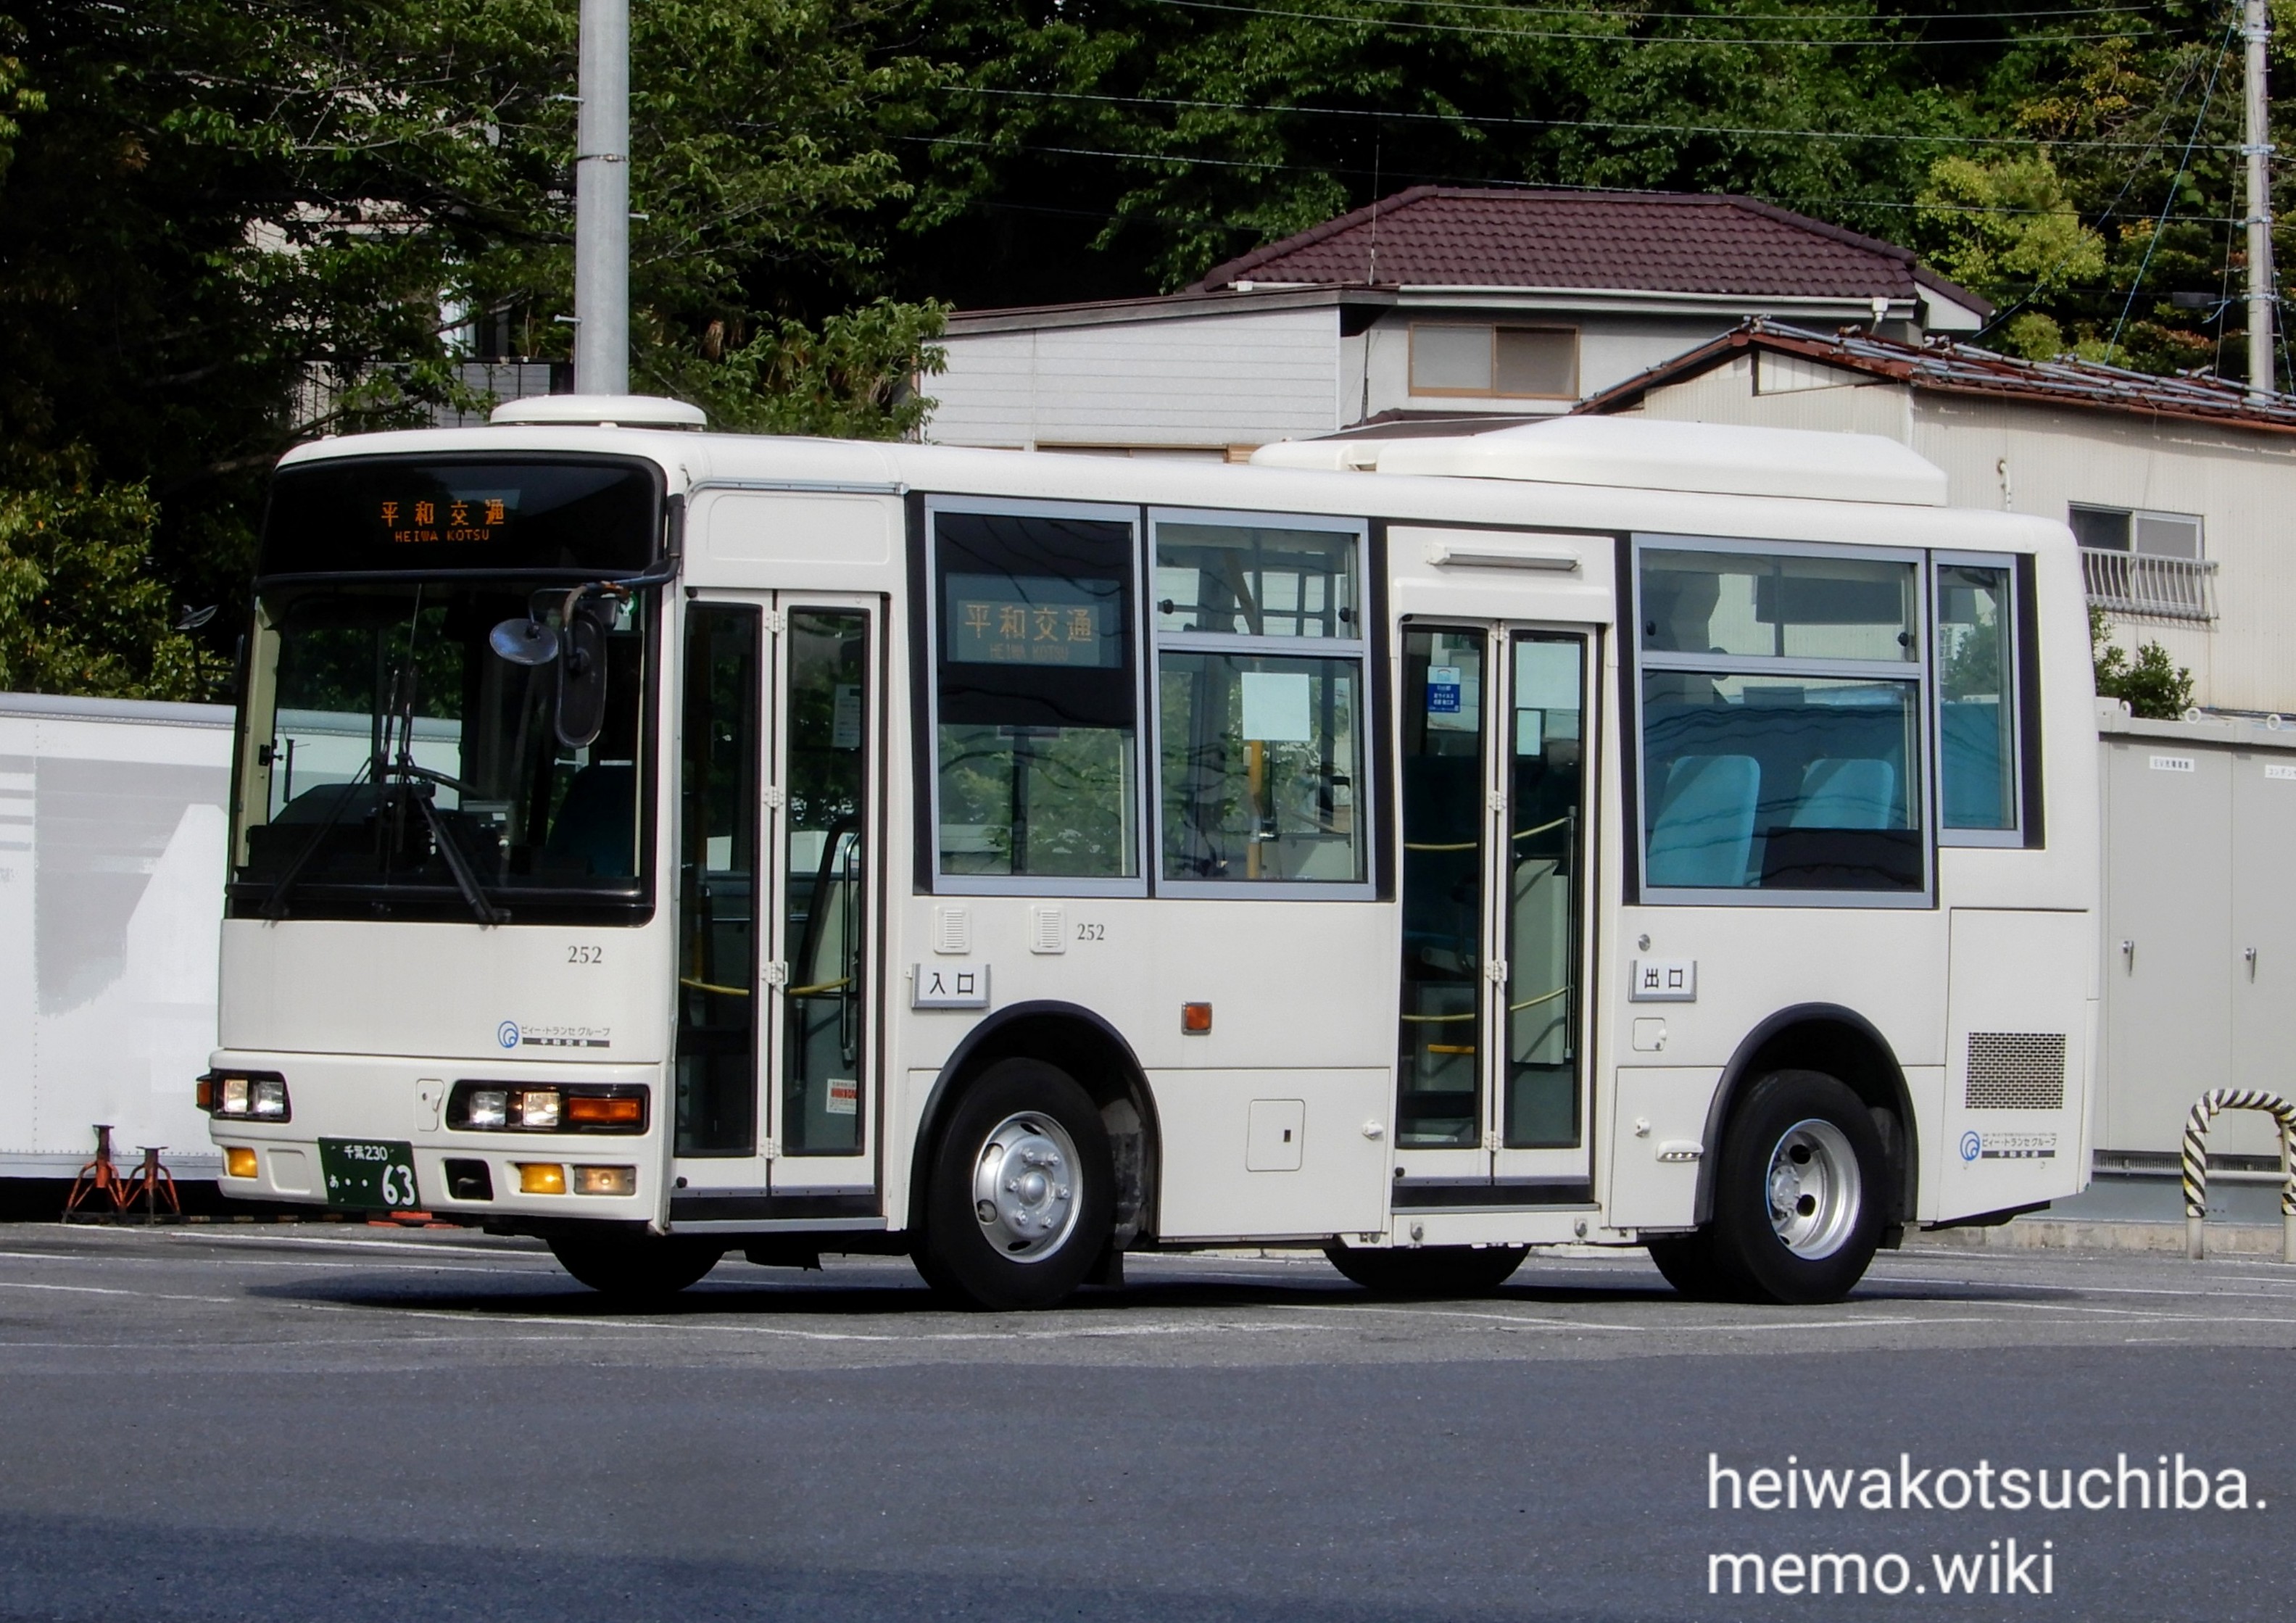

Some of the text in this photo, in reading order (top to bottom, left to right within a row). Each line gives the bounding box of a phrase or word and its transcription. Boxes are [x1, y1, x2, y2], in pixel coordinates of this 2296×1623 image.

[381, 499, 505, 527] 平和交通
[395, 529, 490, 542] HEIWA KOTSU
[965, 604, 1092, 642] 平和交通
[1077, 923, 1105, 940] 252
[568, 945, 602, 963] 252
[929, 973, 974, 995] 入口
[1644, 968, 1683, 989] 出口
